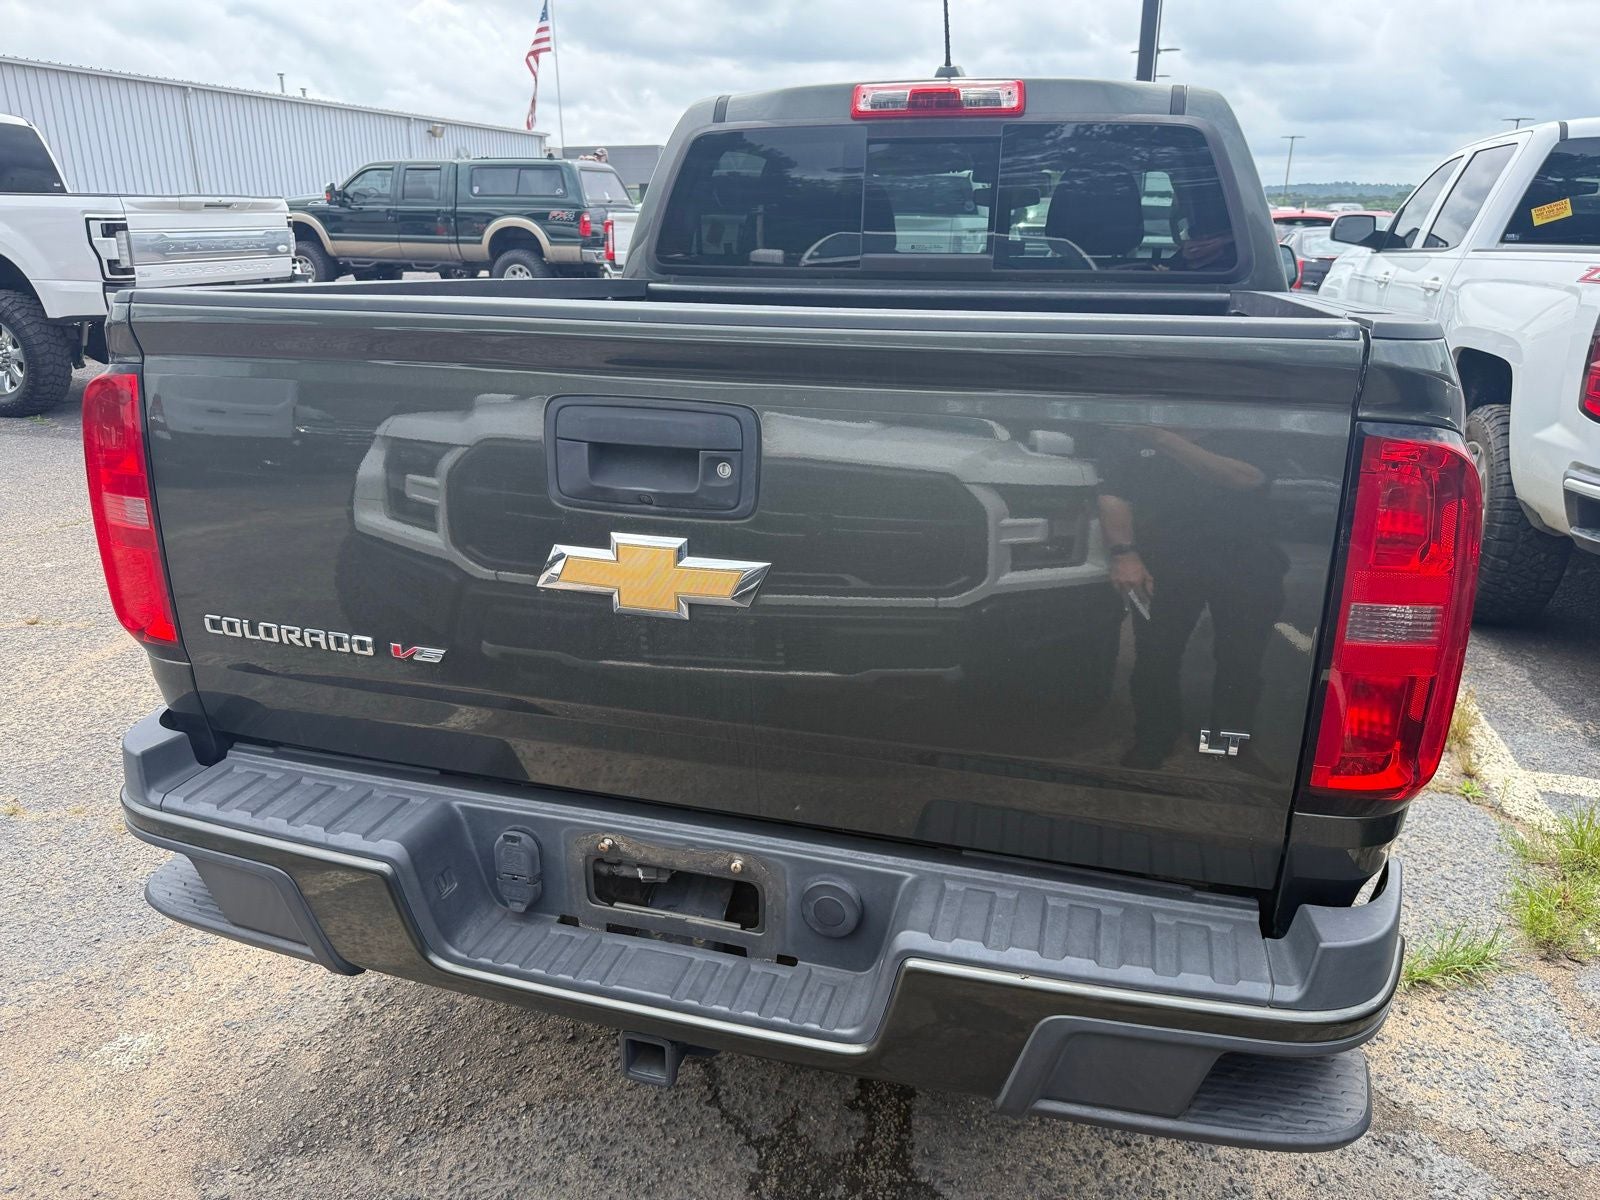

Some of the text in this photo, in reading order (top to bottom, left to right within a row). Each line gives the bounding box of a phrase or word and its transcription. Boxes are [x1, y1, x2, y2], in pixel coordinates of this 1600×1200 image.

[161, 265, 227, 277] SUPER
[232, 262, 273, 273] DUTY
[203, 613, 448, 664] COLORADO V6
[1199, 729, 1251, 756] LT
